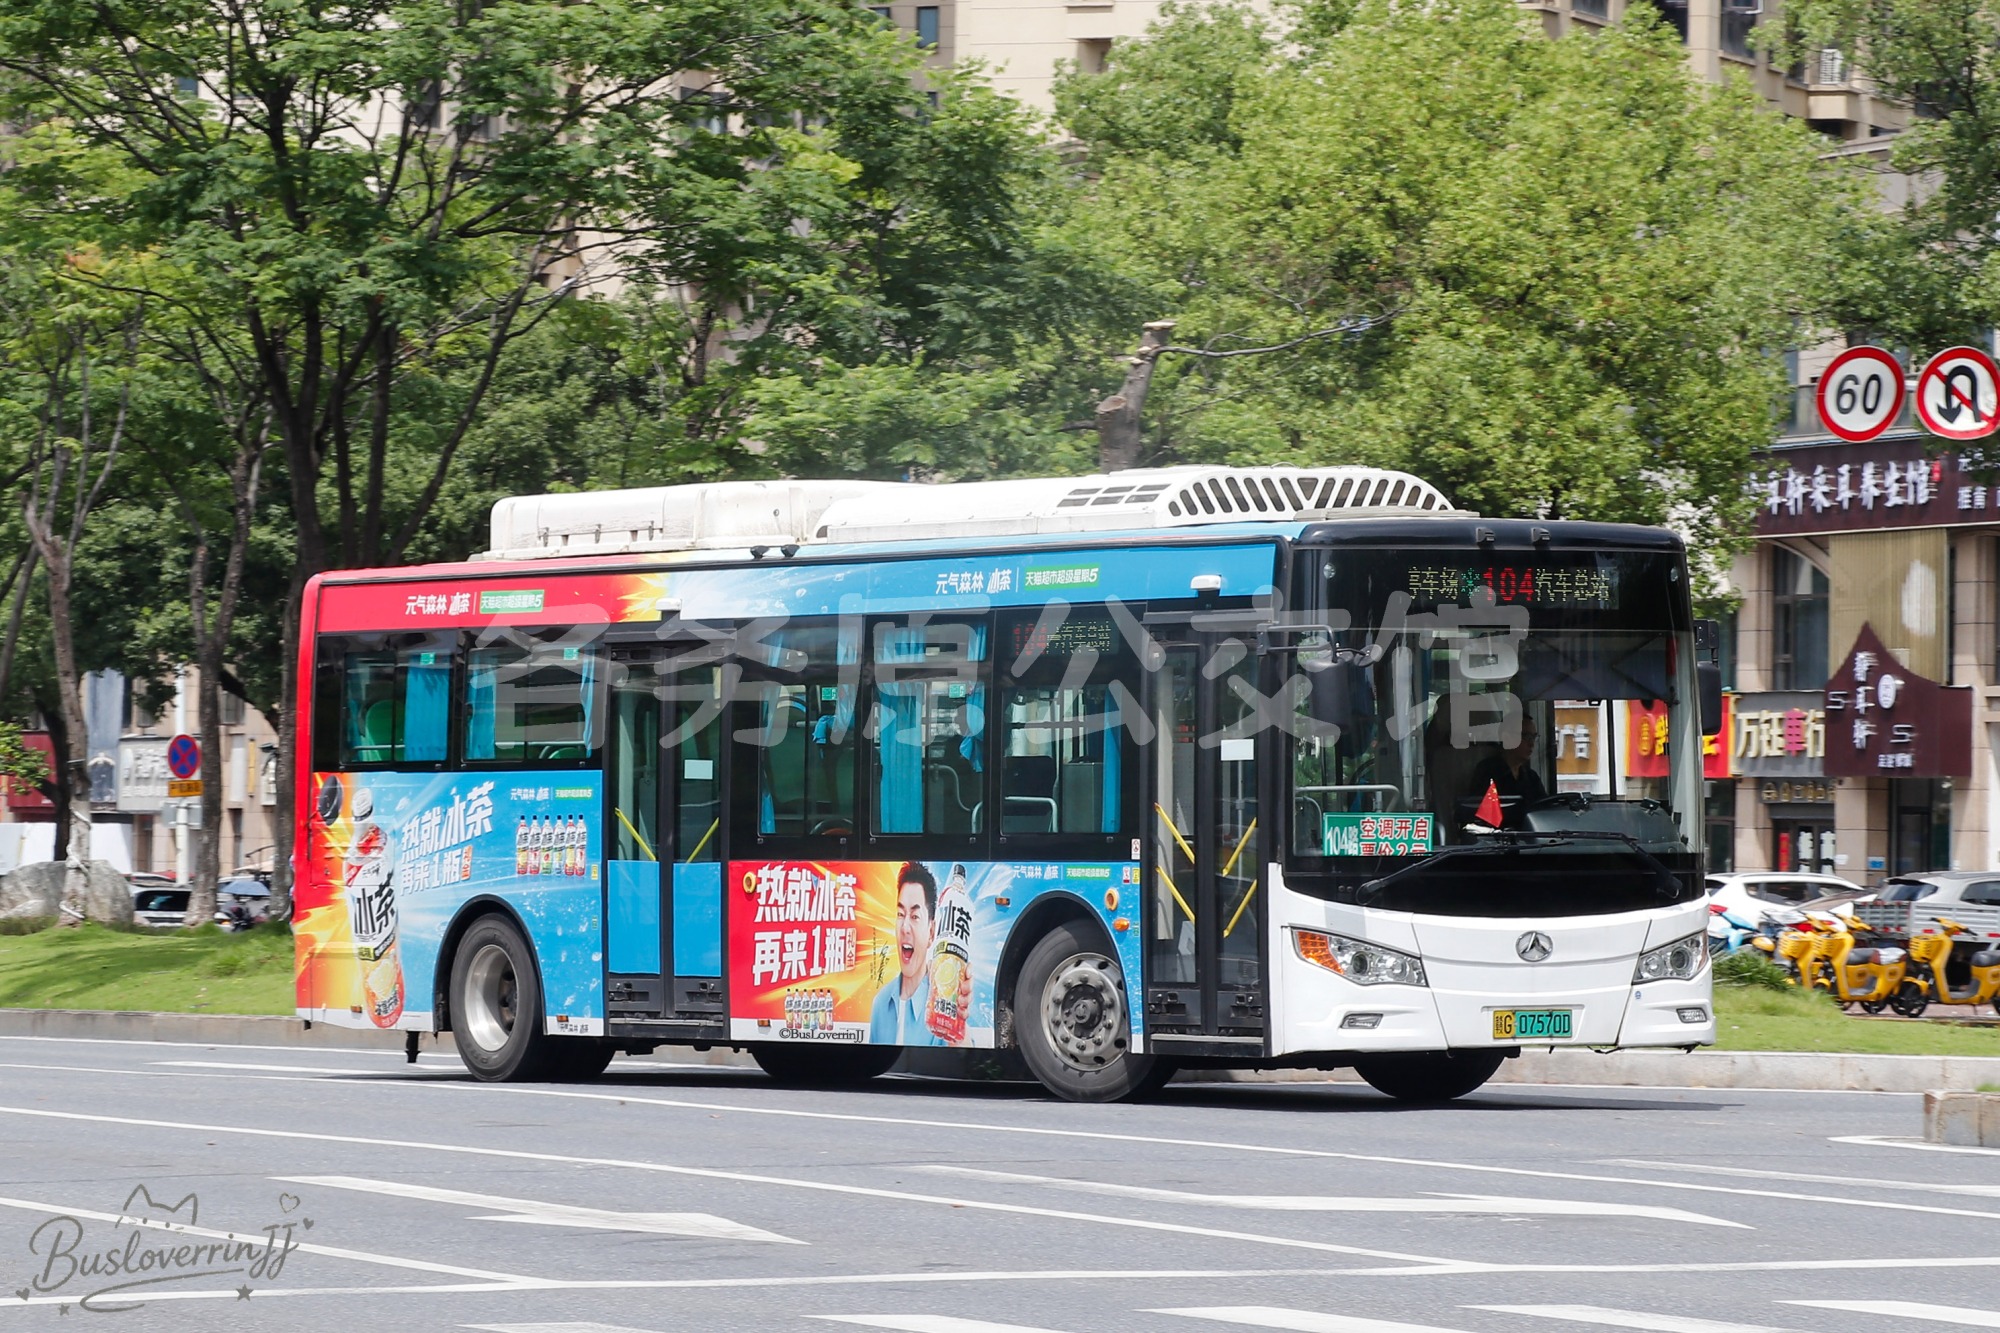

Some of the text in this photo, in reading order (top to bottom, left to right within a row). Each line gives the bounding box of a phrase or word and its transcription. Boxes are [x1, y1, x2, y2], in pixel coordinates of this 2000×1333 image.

[1836, 374, 1882, 415] 60
[405, 594, 448, 615] 元气森林
[448, 592, 471, 616] 冰茶
[935, 568, 1099, 594] 元气森林 冰茶 天猫超市超级星期5
[1483, 567, 1534, 601] 104
[1535, 568, 1610, 601] 汽车总站
[401, 780, 496, 863] 热就冰茶
[1360, 816, 1430, 840] 空调开启
[400, 847, 462, 897] 再来1瓶
[754, 861, 857, 922] 热就冰茶
[353, 868, 396, 935] 冰茶
[937, 899, 973, 946] 冰茶
[752, 924, 846, 986] 再来1瓶
